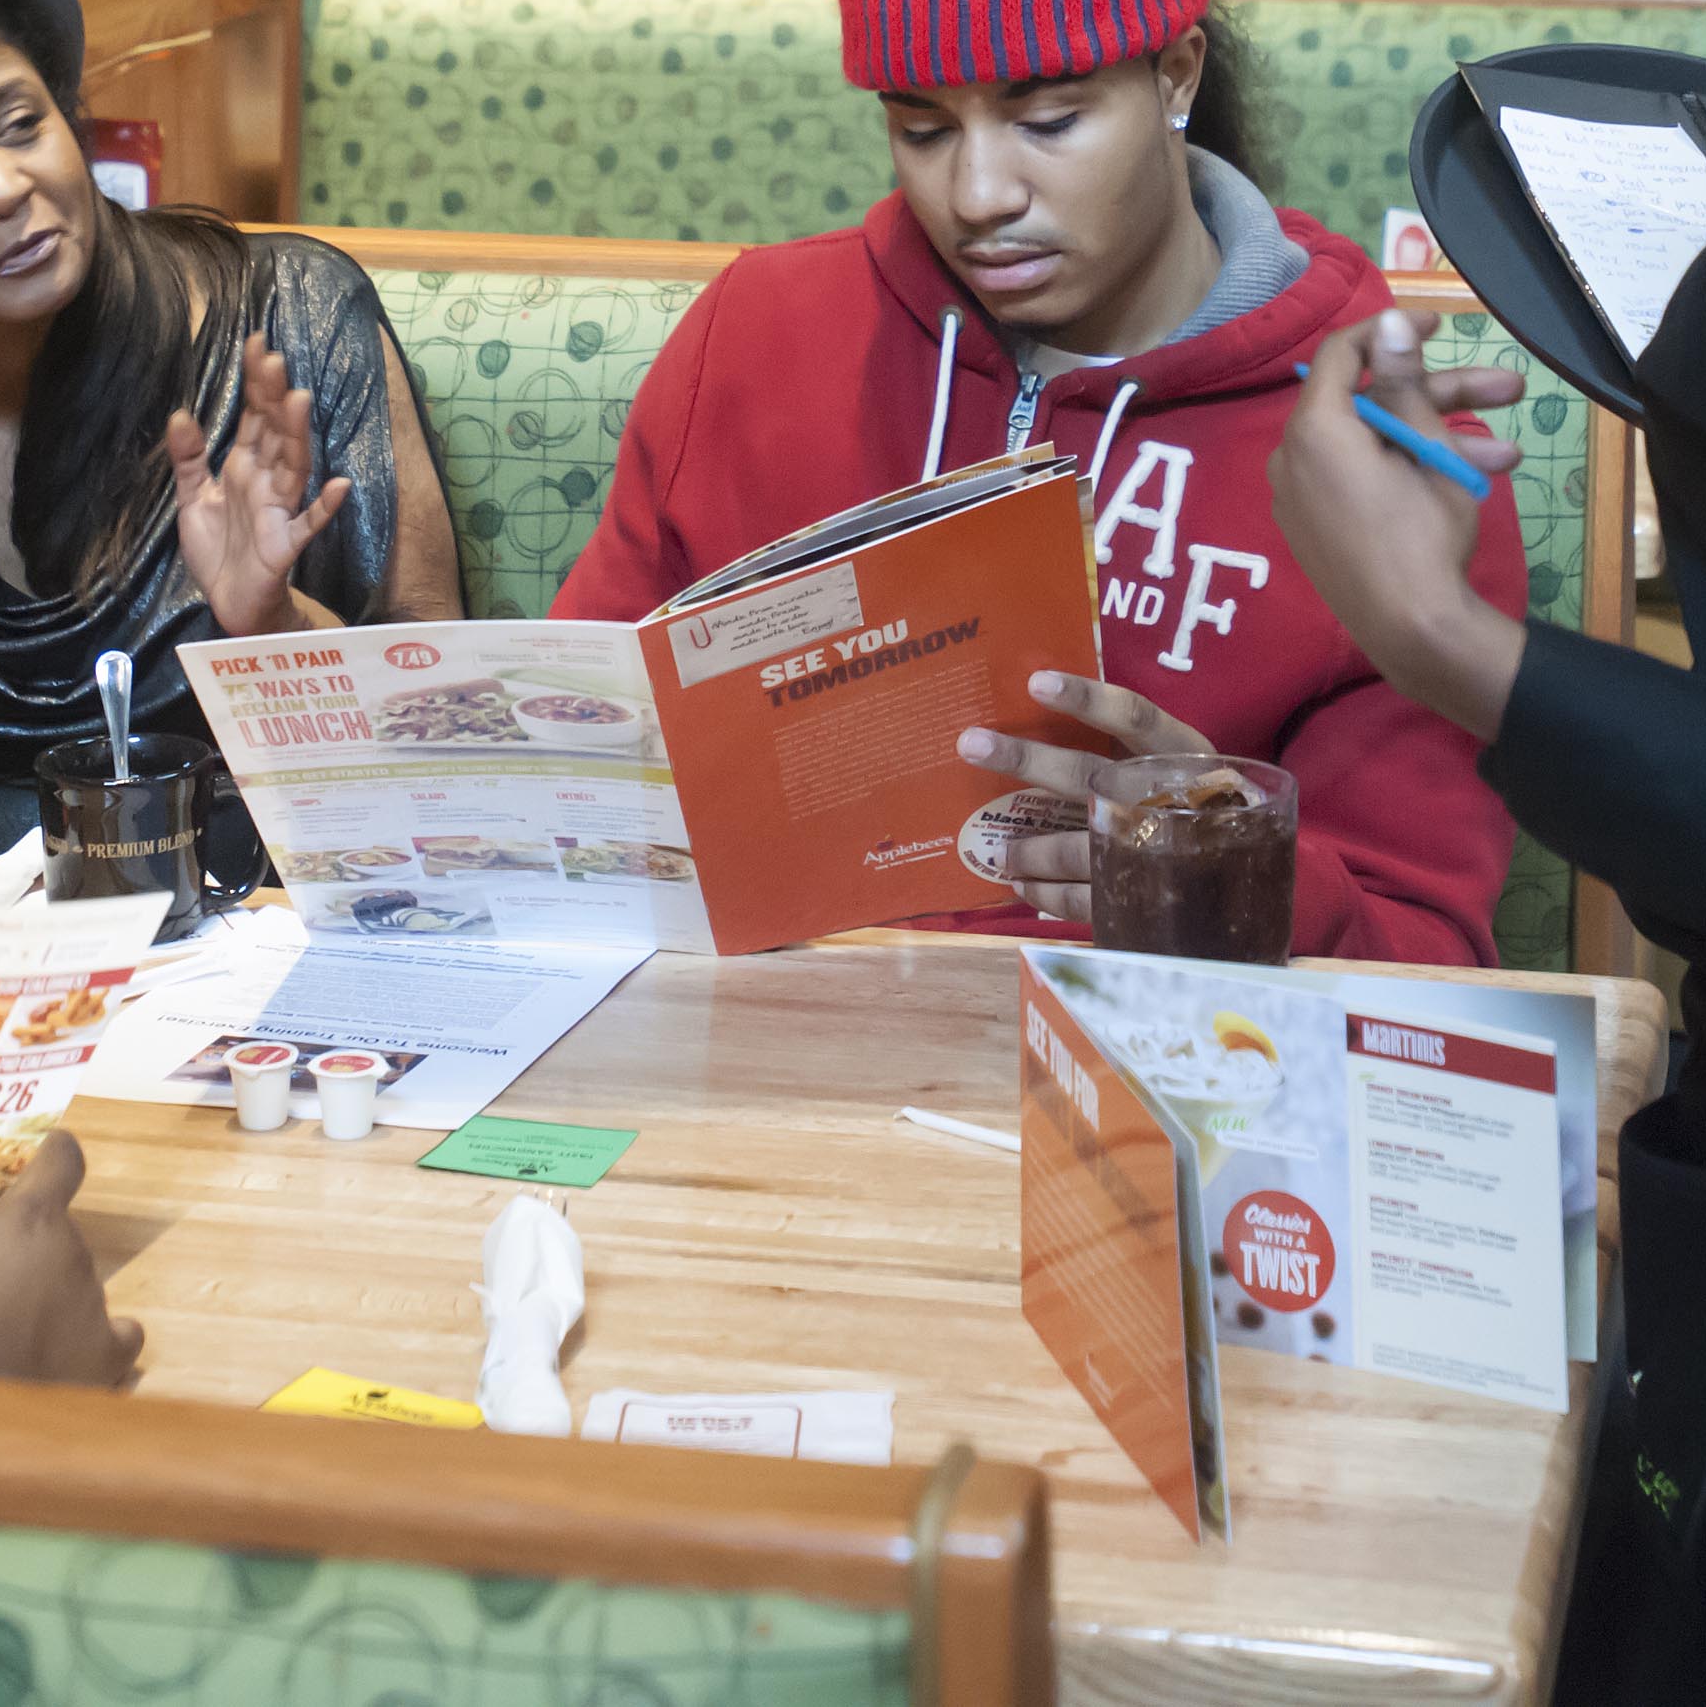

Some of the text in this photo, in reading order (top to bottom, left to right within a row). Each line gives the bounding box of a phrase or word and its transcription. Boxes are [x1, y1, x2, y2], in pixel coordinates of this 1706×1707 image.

[1094, 440, 1194, 579] A
[1157, 543, 1270, 672] F
[210, 653, 264, 677] PICK
[293, 648, 345, 669] PAIR
[759, 617, 909, 689] SEE YOU
[763, 615, 982, 709] TOMORROW
[254, 676, 321, 699] WAYS
[323, 674, 355, 694] TO
[230, 694, 360, 718] RECLAIM YOUR
[237, 709, 374, 750] LUNCH
[980, 811, 1035, 826] black
[87, 839, 155, 859] PREMIUM
[157, 828, 196, 855] BLEND
[255, 1024, 335, 1042] Training
[344, 1034, 380, 1045] Our
[385, 1037, 408, 1048] To
[415, 1041, 509, 1057] Welcome
[1253, 1227, 1307, 1250] WITH A
[1239, 1240, 1321, 1299] TWIST
